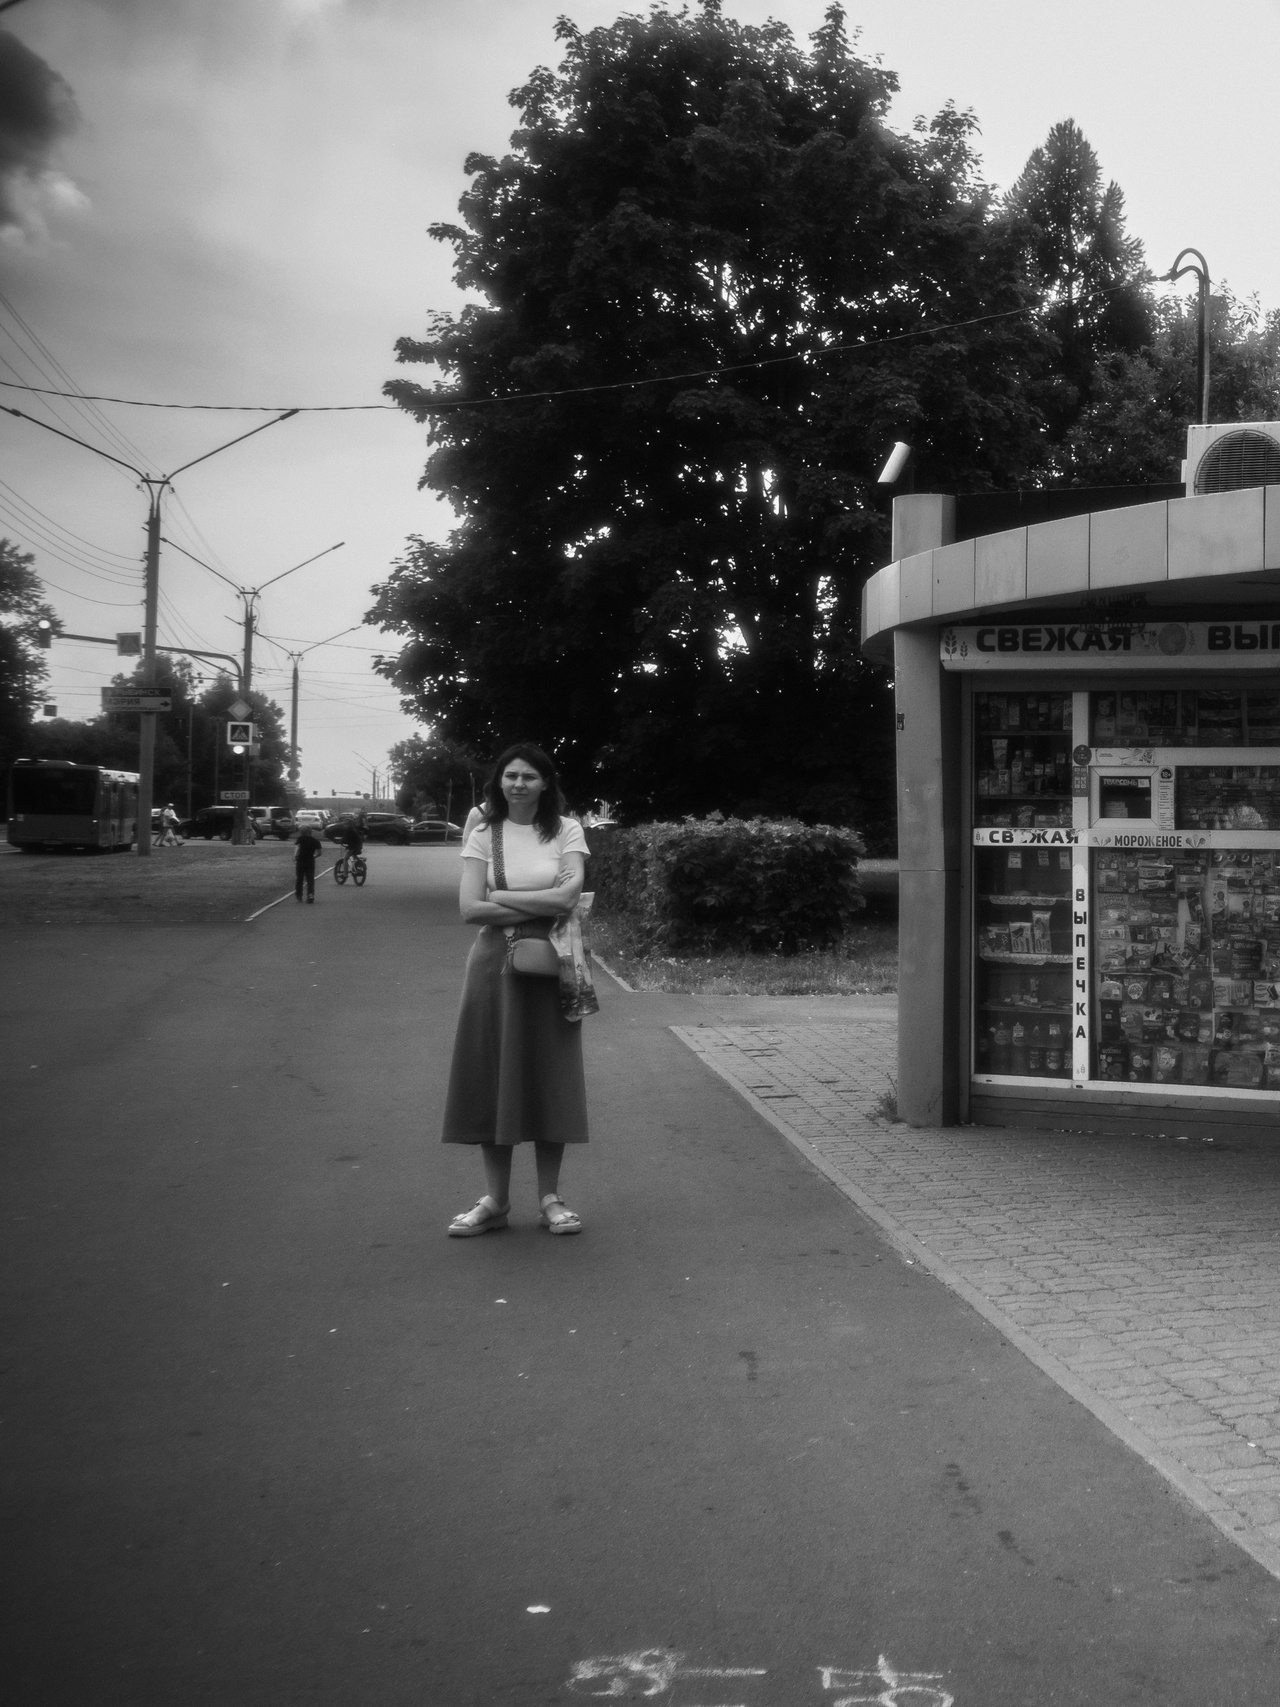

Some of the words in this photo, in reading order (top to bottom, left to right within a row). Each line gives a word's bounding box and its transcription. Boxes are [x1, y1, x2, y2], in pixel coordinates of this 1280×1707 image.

[976, 627, 1132, 653] СВЕЖАЯ
[103, 698, 140, 706] МЭРИЯ
[989, 829, 1080, 845] СВЖАЯ
[1114, 835, 1183, 848] МОРОЖЕНОЕ
[1074, 888, 1087, 1039] ВЫПЕЧКА
